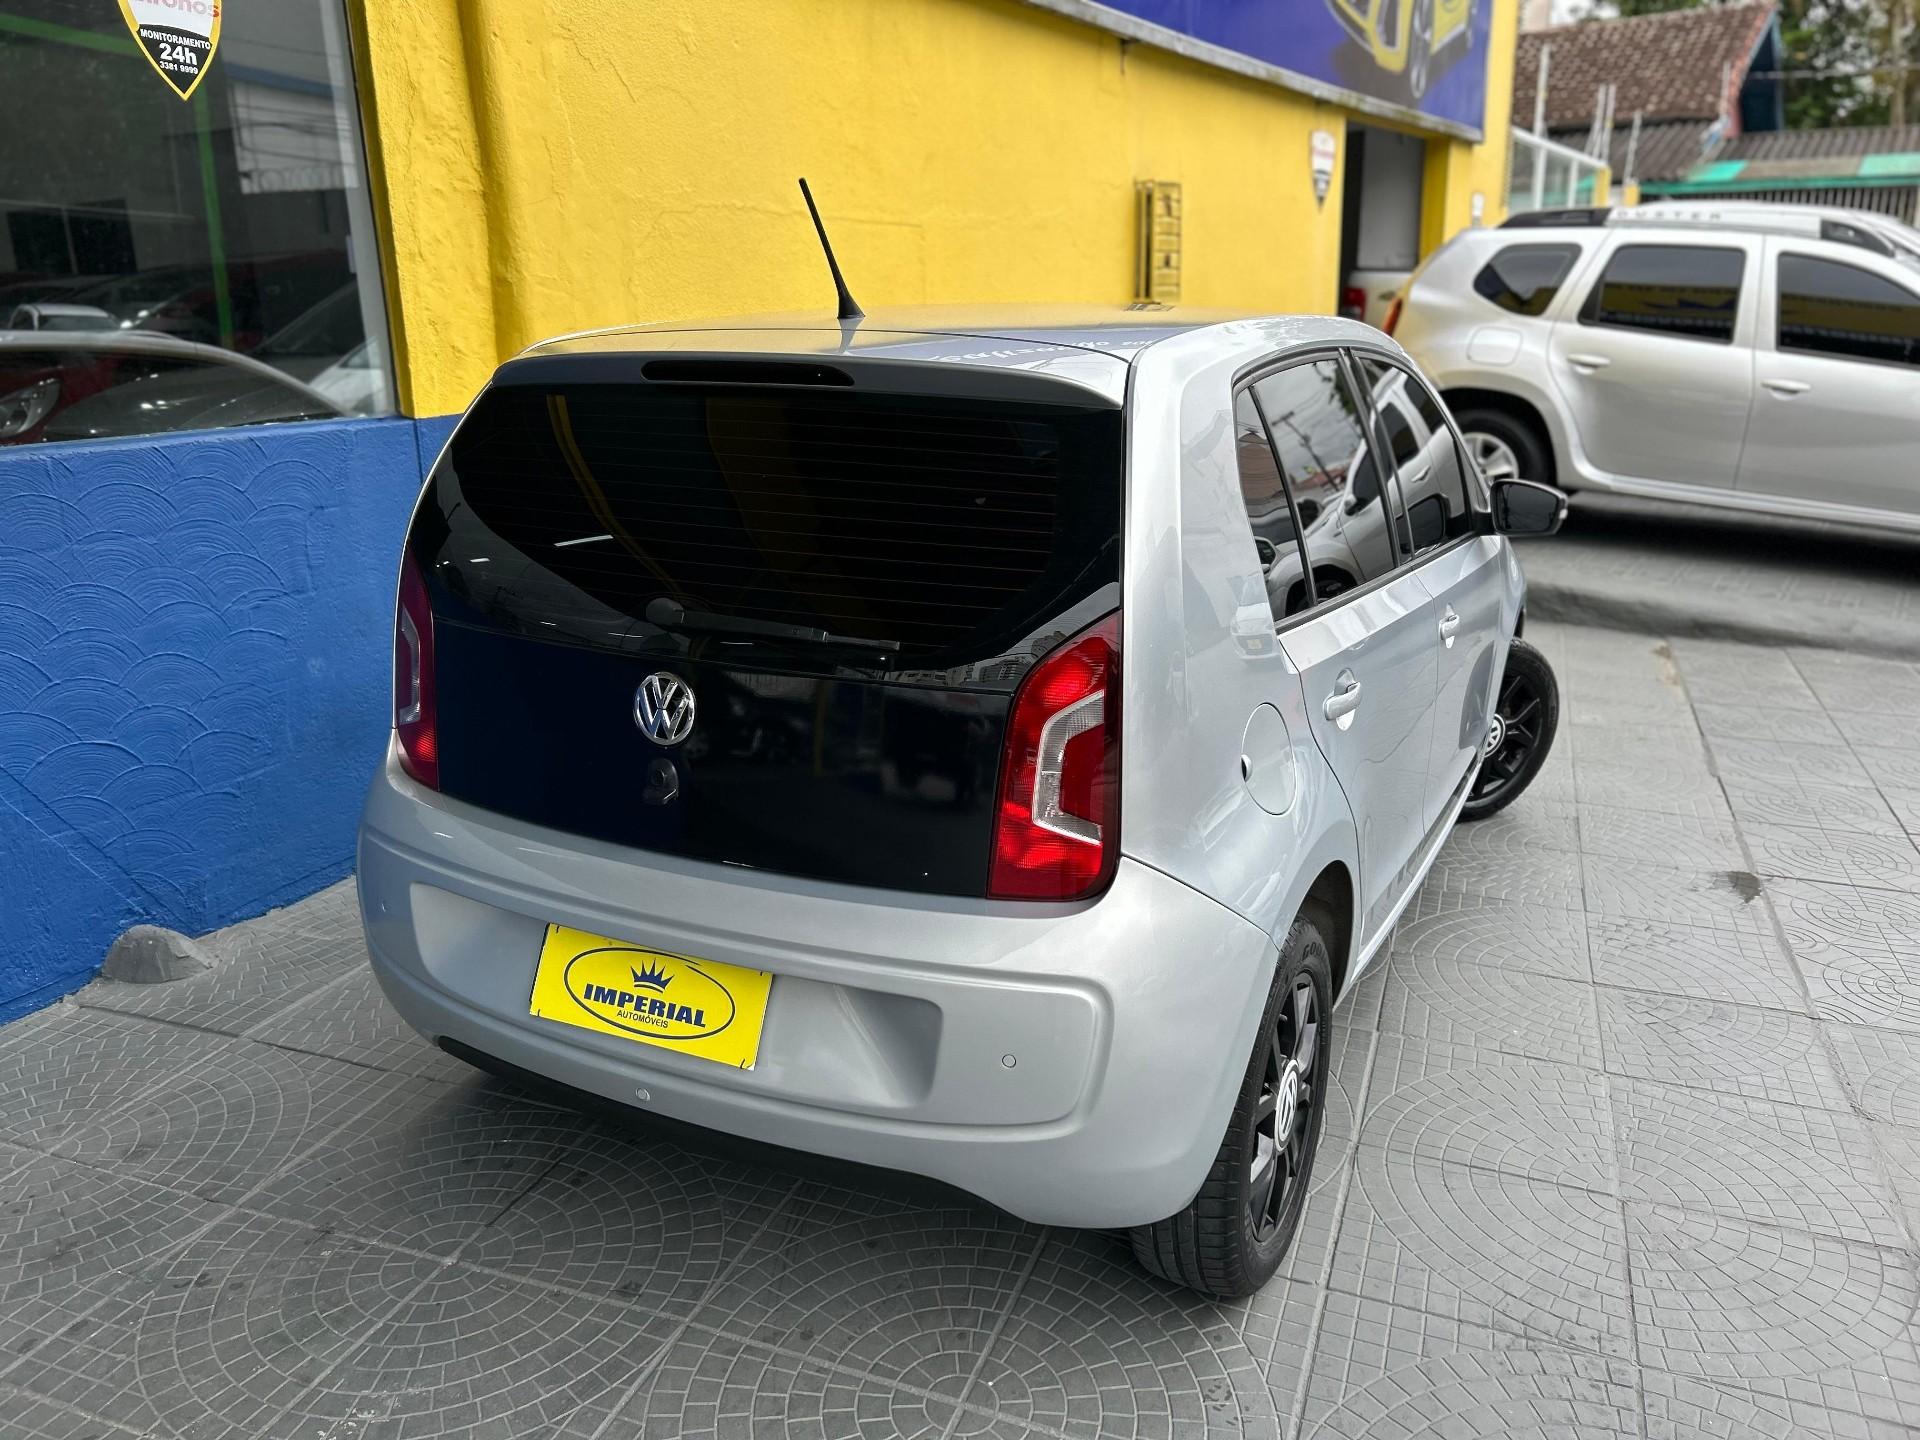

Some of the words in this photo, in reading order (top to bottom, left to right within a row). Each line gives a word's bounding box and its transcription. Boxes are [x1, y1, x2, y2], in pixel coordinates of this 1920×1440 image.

[140, 29, 212, 50] MONITORAMENTO
[159, 42, 198, 66] 24h
[160, 60, 178, 71] 3381
[179, 65, 199, 75] 9999
[583, 983, 706, 1029] IMPERIAL
[616, 1009, 669, 1029] AUTOMÓVEIS
